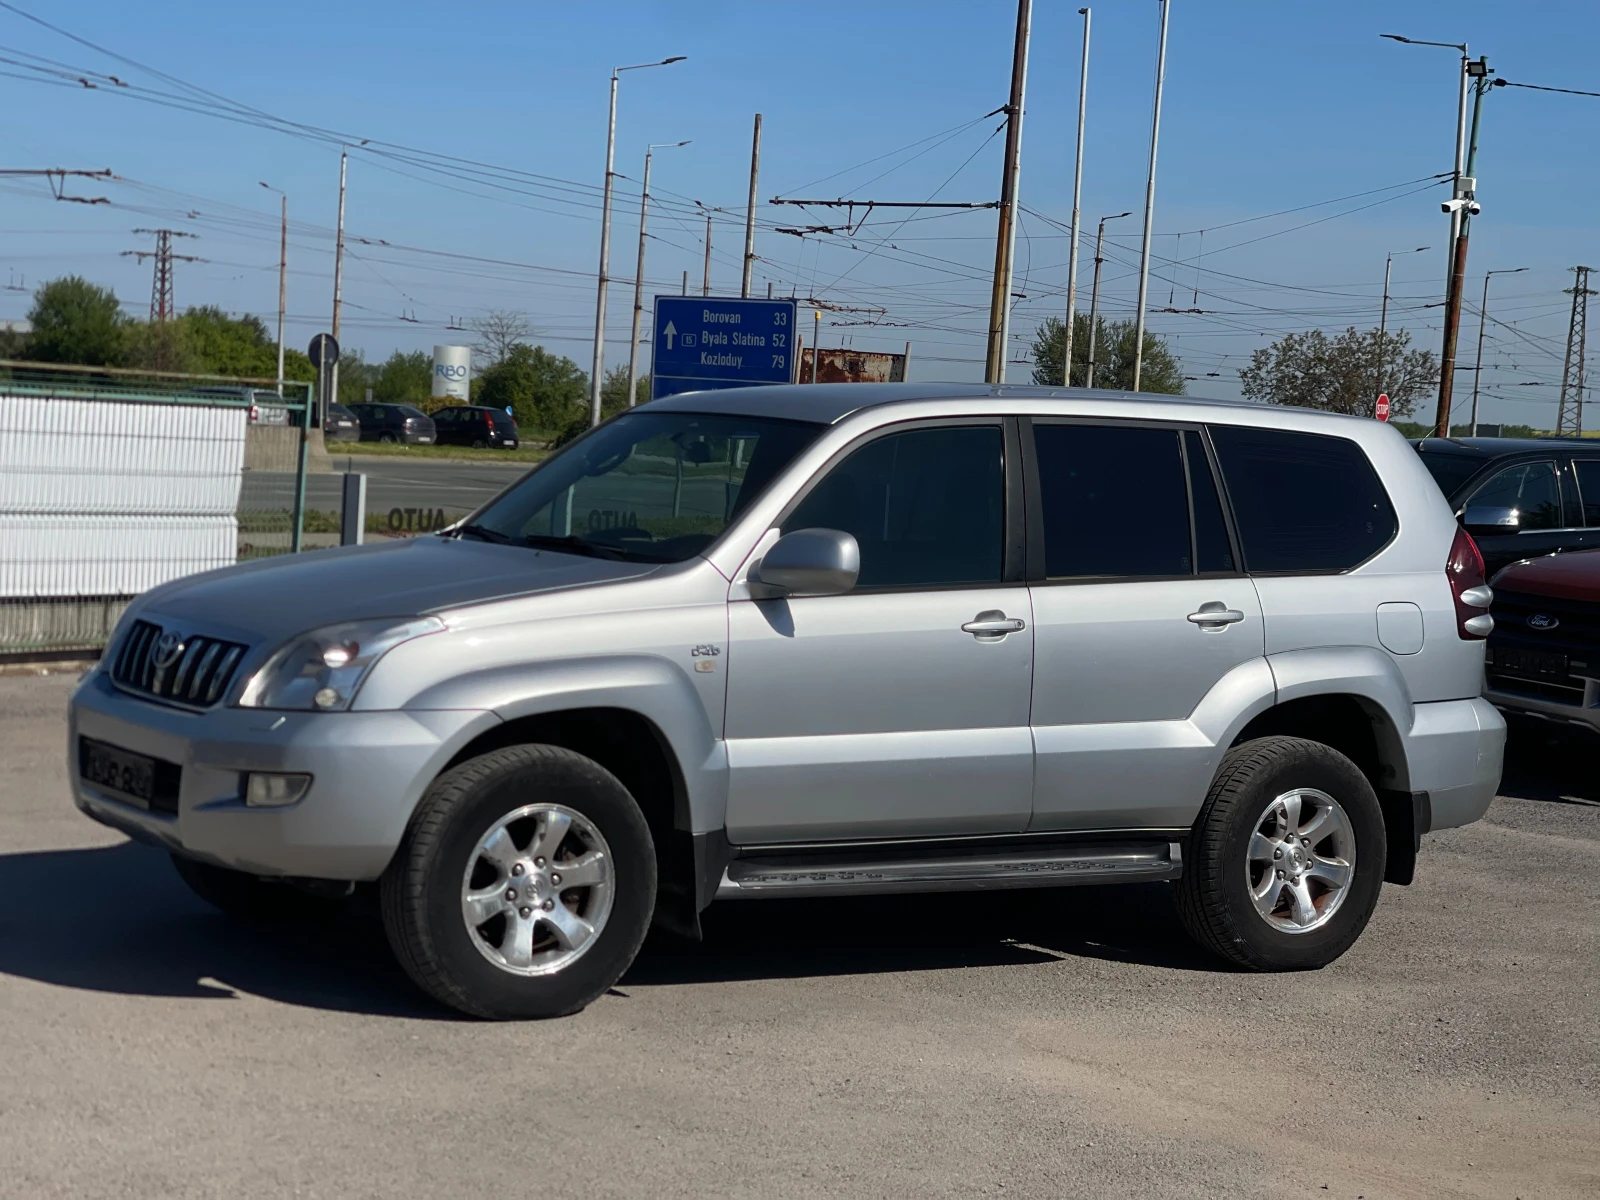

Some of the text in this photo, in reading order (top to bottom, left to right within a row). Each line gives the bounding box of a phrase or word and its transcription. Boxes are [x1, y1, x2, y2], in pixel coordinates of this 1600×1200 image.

[703, 309, 787, 326] Borovan 33
[701, 331, 728, 347] Byala
[732, 332, 766, 347] Slatina
[772, 333, 786, 348] 52
[701, 352, 785, 370] Kozloduy 79
[436, 364, 467, 378] RBO
[1377, 404, 1389, 415] STOP
[1531, 614, 1550, 627] Ford
